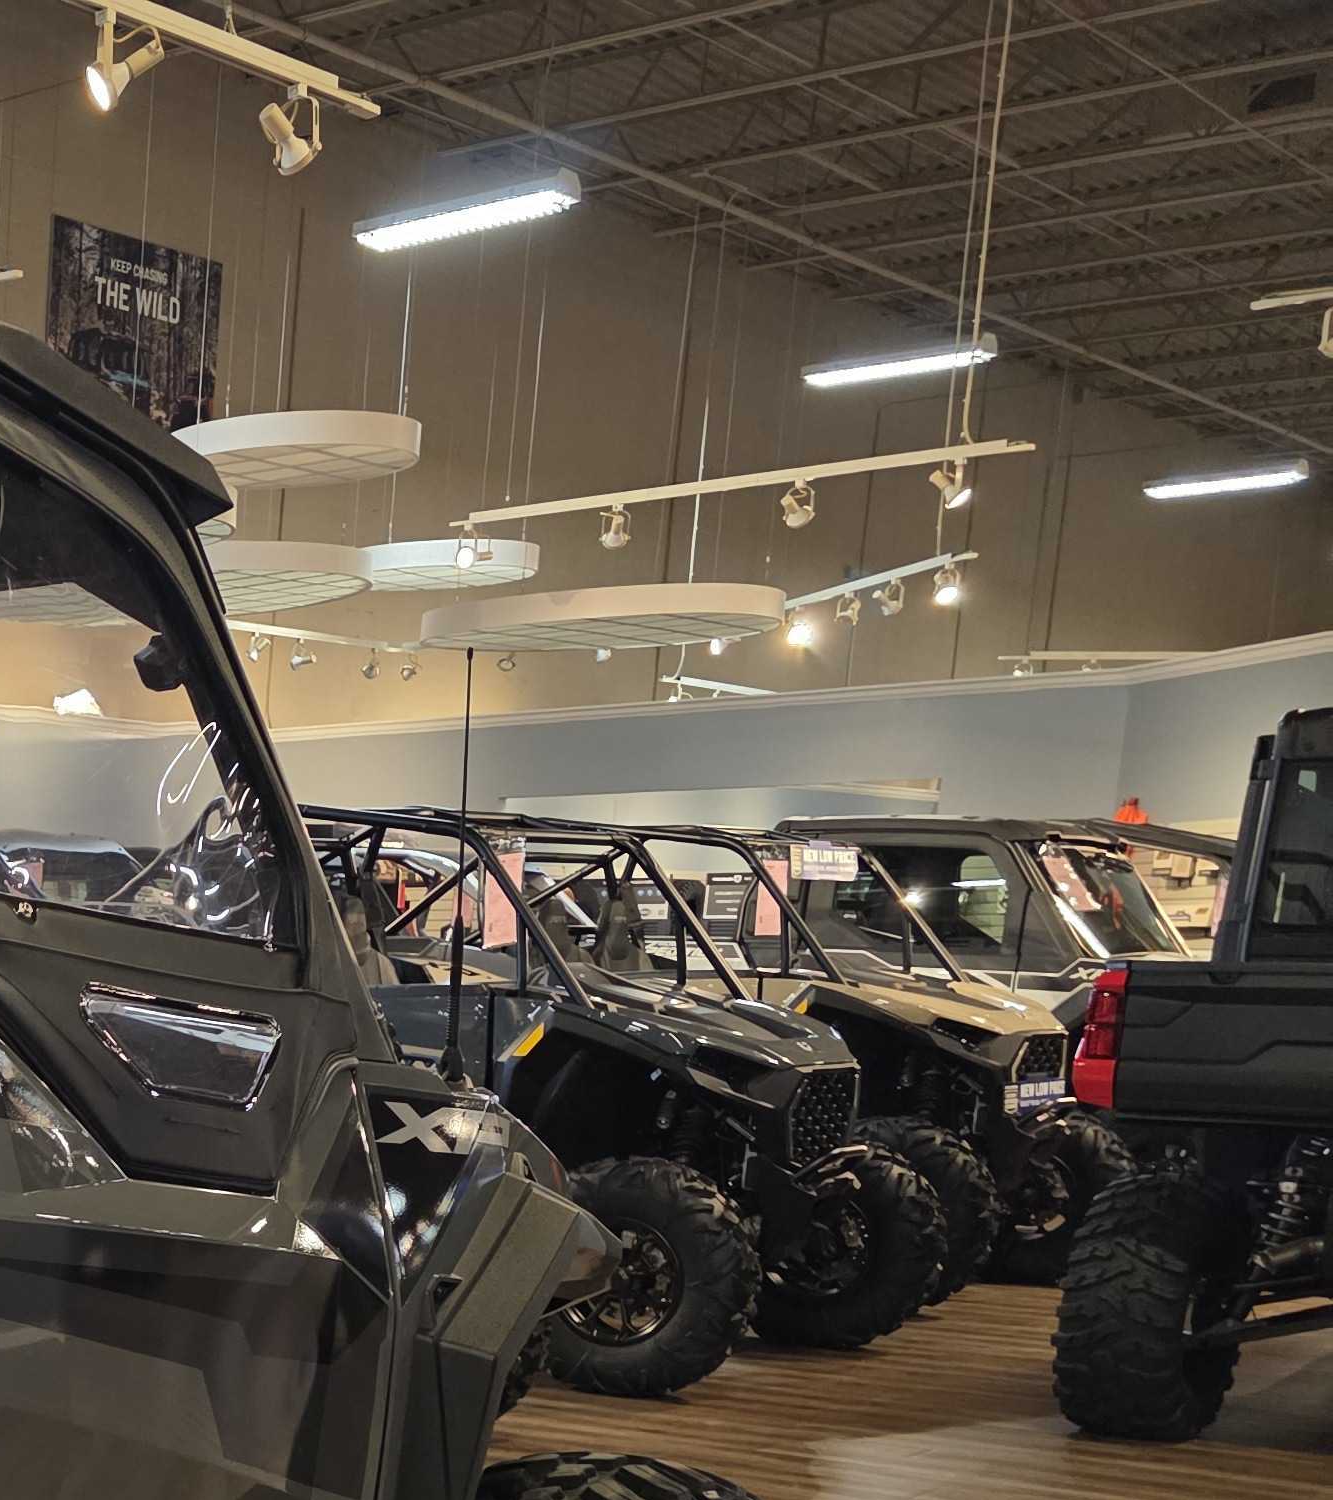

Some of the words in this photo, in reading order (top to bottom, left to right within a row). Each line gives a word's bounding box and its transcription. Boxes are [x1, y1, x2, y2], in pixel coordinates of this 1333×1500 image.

[110, 258, 132, 274] KEEP
[94, 275, 131, 312] THE
[136, 287, 181, 324] WILD
